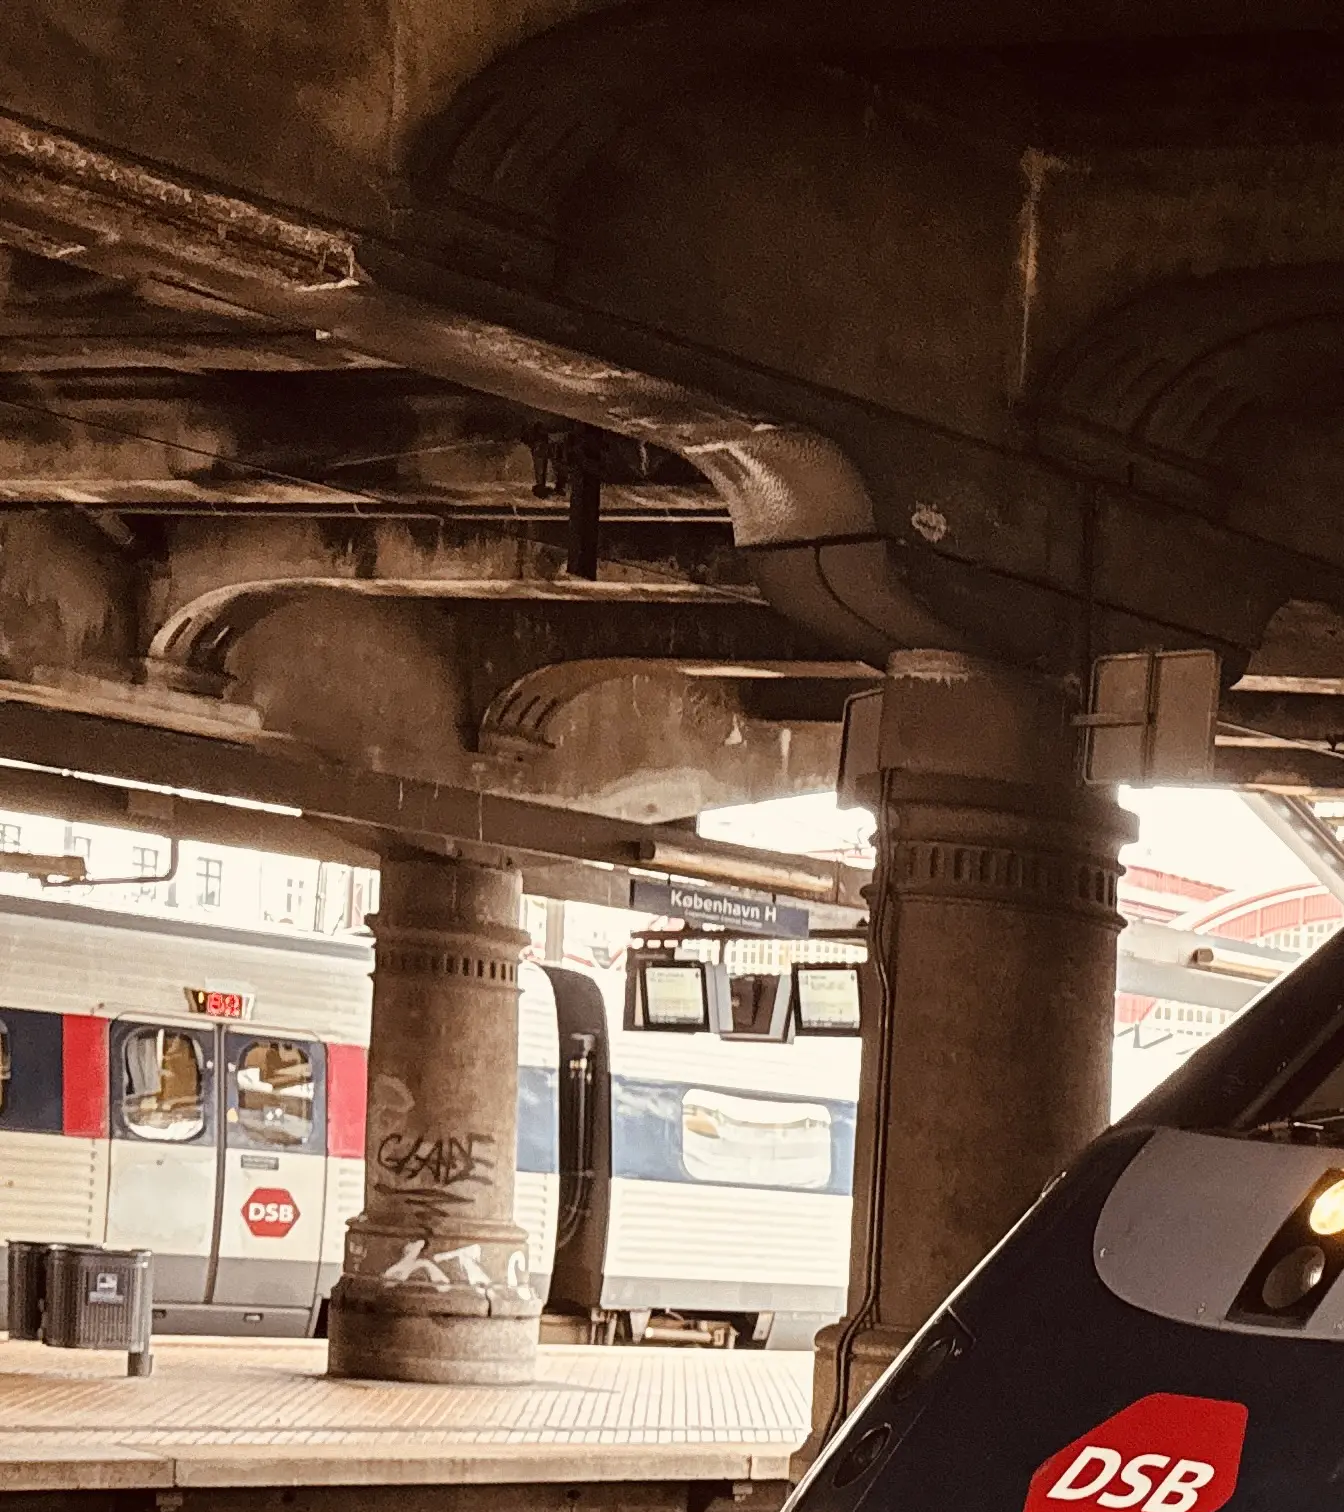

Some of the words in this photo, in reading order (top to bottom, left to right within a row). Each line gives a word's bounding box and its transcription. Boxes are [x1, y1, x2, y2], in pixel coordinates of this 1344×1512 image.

[671, 889, 760, 919] København
[765, 905, 777, 923] H
[249, 1202, 293, 1222] DSB
